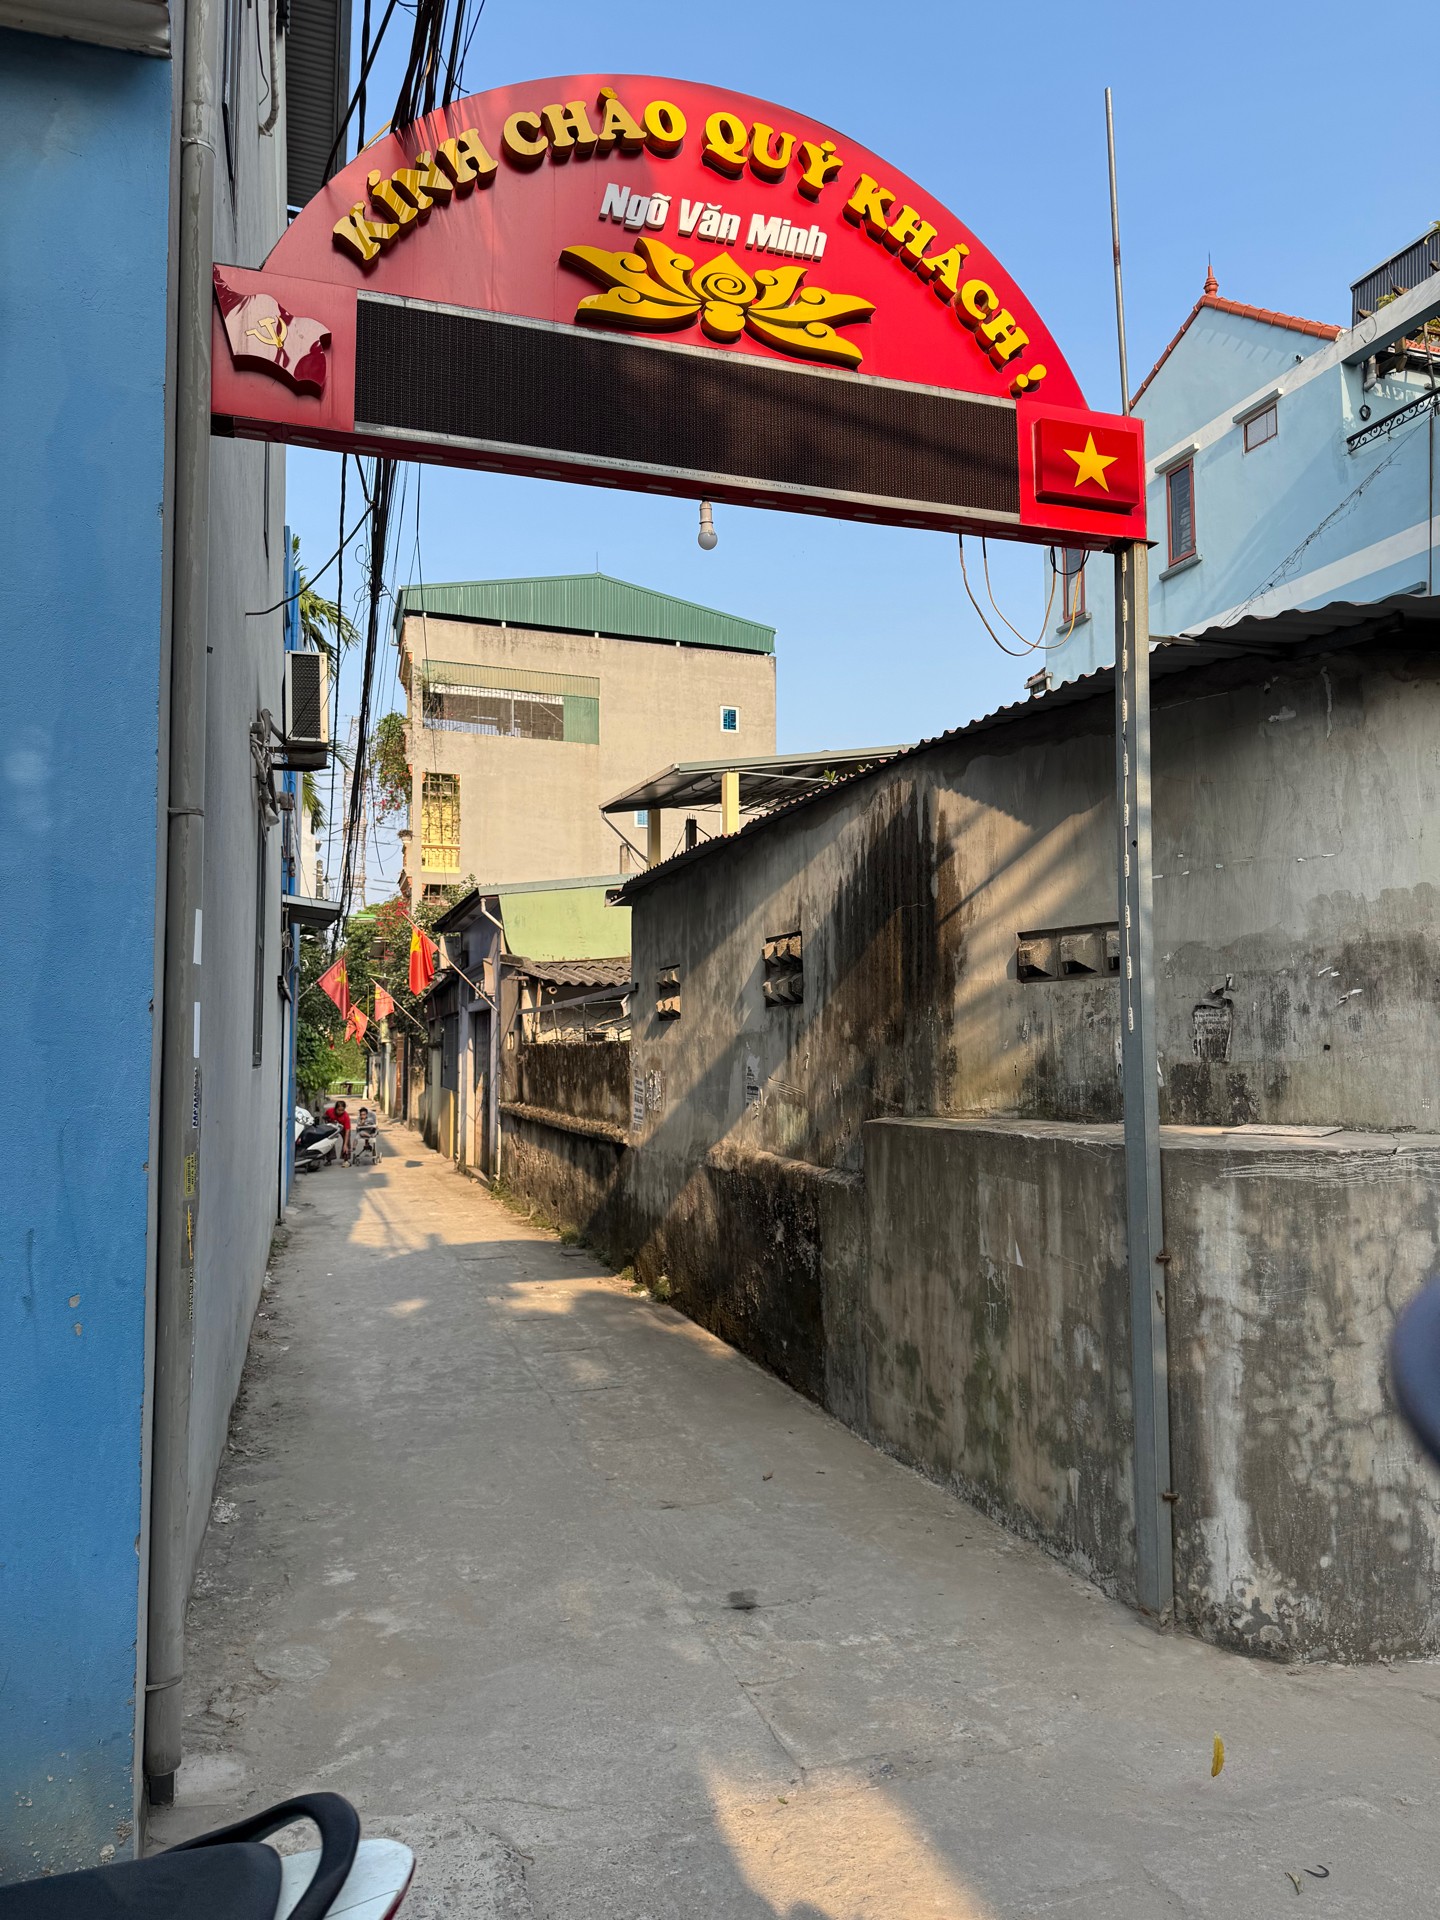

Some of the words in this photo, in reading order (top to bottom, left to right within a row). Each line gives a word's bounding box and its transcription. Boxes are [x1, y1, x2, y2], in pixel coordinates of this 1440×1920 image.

[332, 128, 499, 267] KÍNH
[502, 86, 688, 162] CHÀO
[702, 111, 843, 195] QUÝ
[845, 172, 1030, 366] KHÁCH
[599, 182, 672, 230] Ngõ
[678, 198, 741, 244] Văn
[745, 213, 827, 260] Minh
